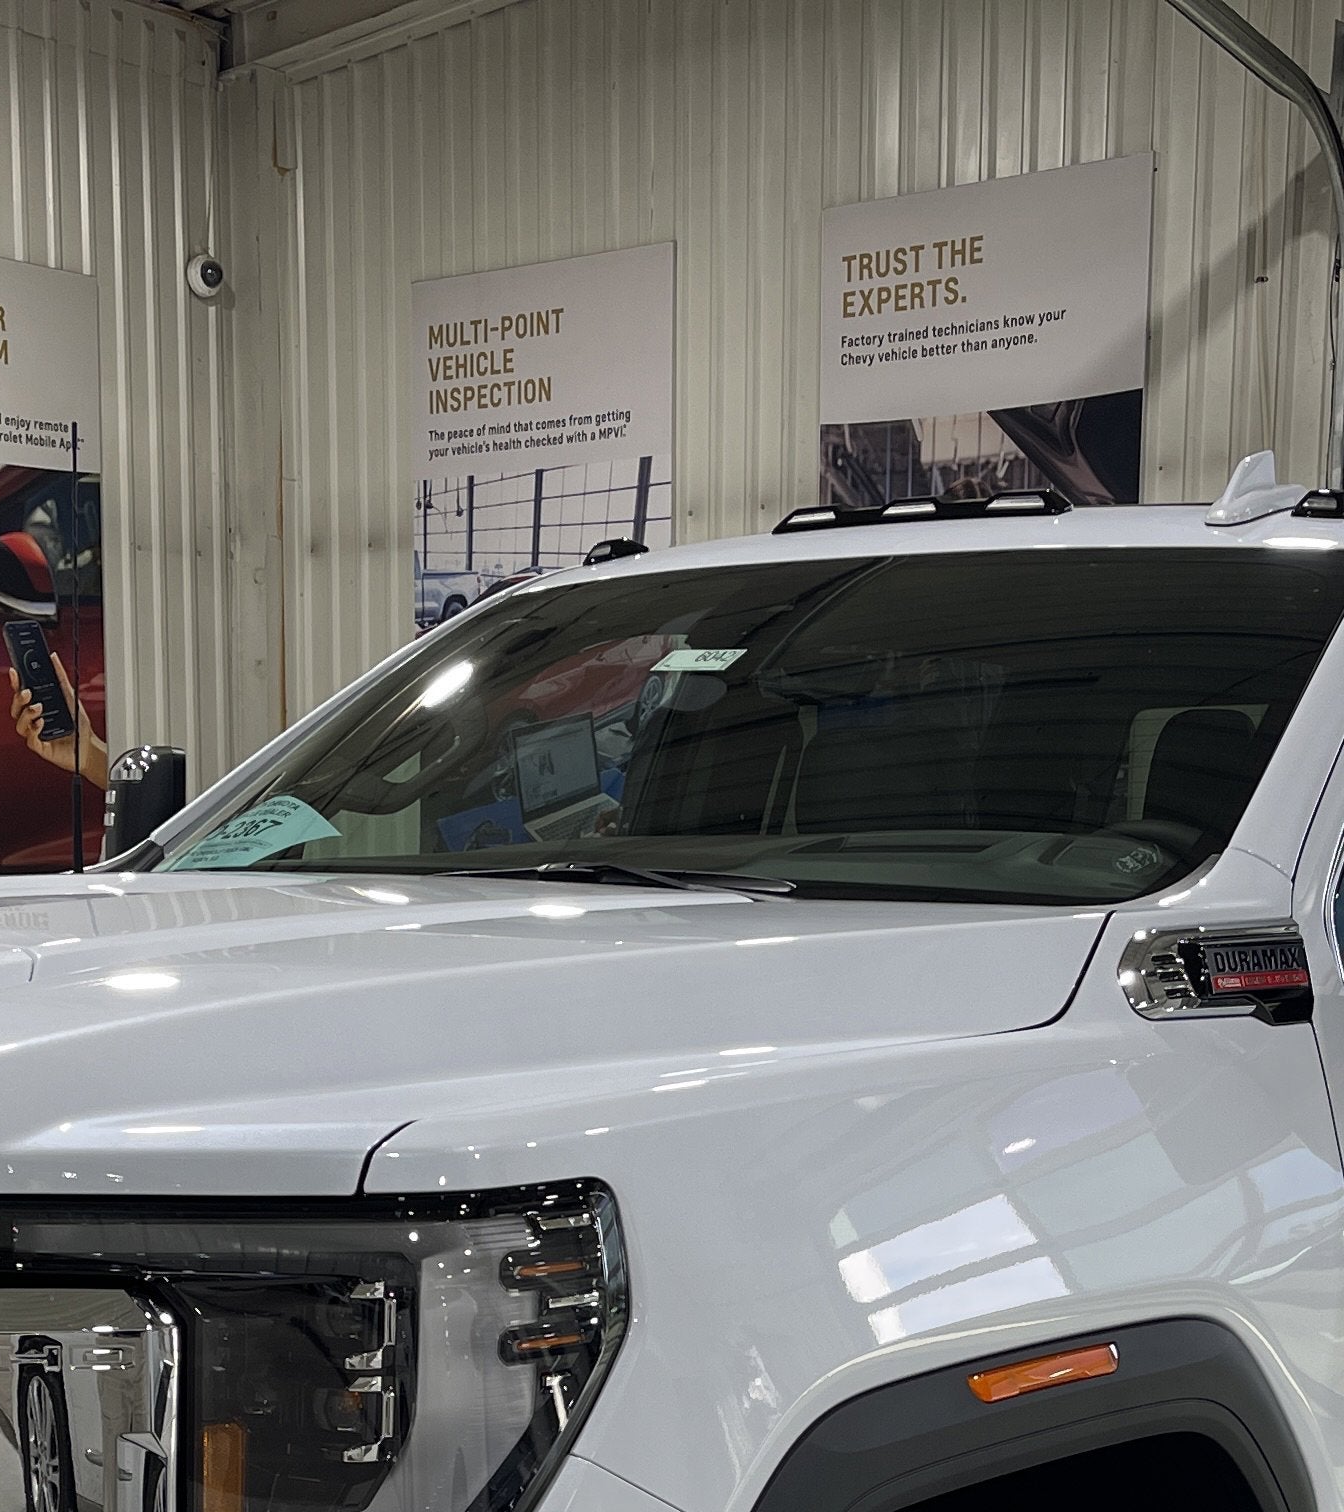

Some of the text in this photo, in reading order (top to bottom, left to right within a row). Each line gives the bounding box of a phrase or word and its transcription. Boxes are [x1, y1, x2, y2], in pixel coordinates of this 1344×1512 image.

[842, 234, 984, 283] TRUST THE
[842, 276, 968, 319] EXPERTS.
[427, 308, 565, 350] MULTI-POINT
[841, 308, 1067, 348] Factory trained technicians know your
[427, 348, 515, 382] VEHICLE
[840, 333, 1038, 367] Chevy vehicle better than anyone.
[428, 376, 552, 415] INSPECTION
[4, 415, 31, 431] enjoy
[34, 420, 69, 433] remote
[25, 433, 57, 448] Mobile
[428, 410, 631, 443] The peace of mind that comes from getting
[428, 446, 450, 462] your
[451, 441, 491, 457] vehicle's
[492, 438, 522, 452] health
[524, 433, 564, 449] checked
[566, 430, 587, 444] with
[590, 430, 596, 441] a
[1213, 946, 1301, 973] DURAMAX
